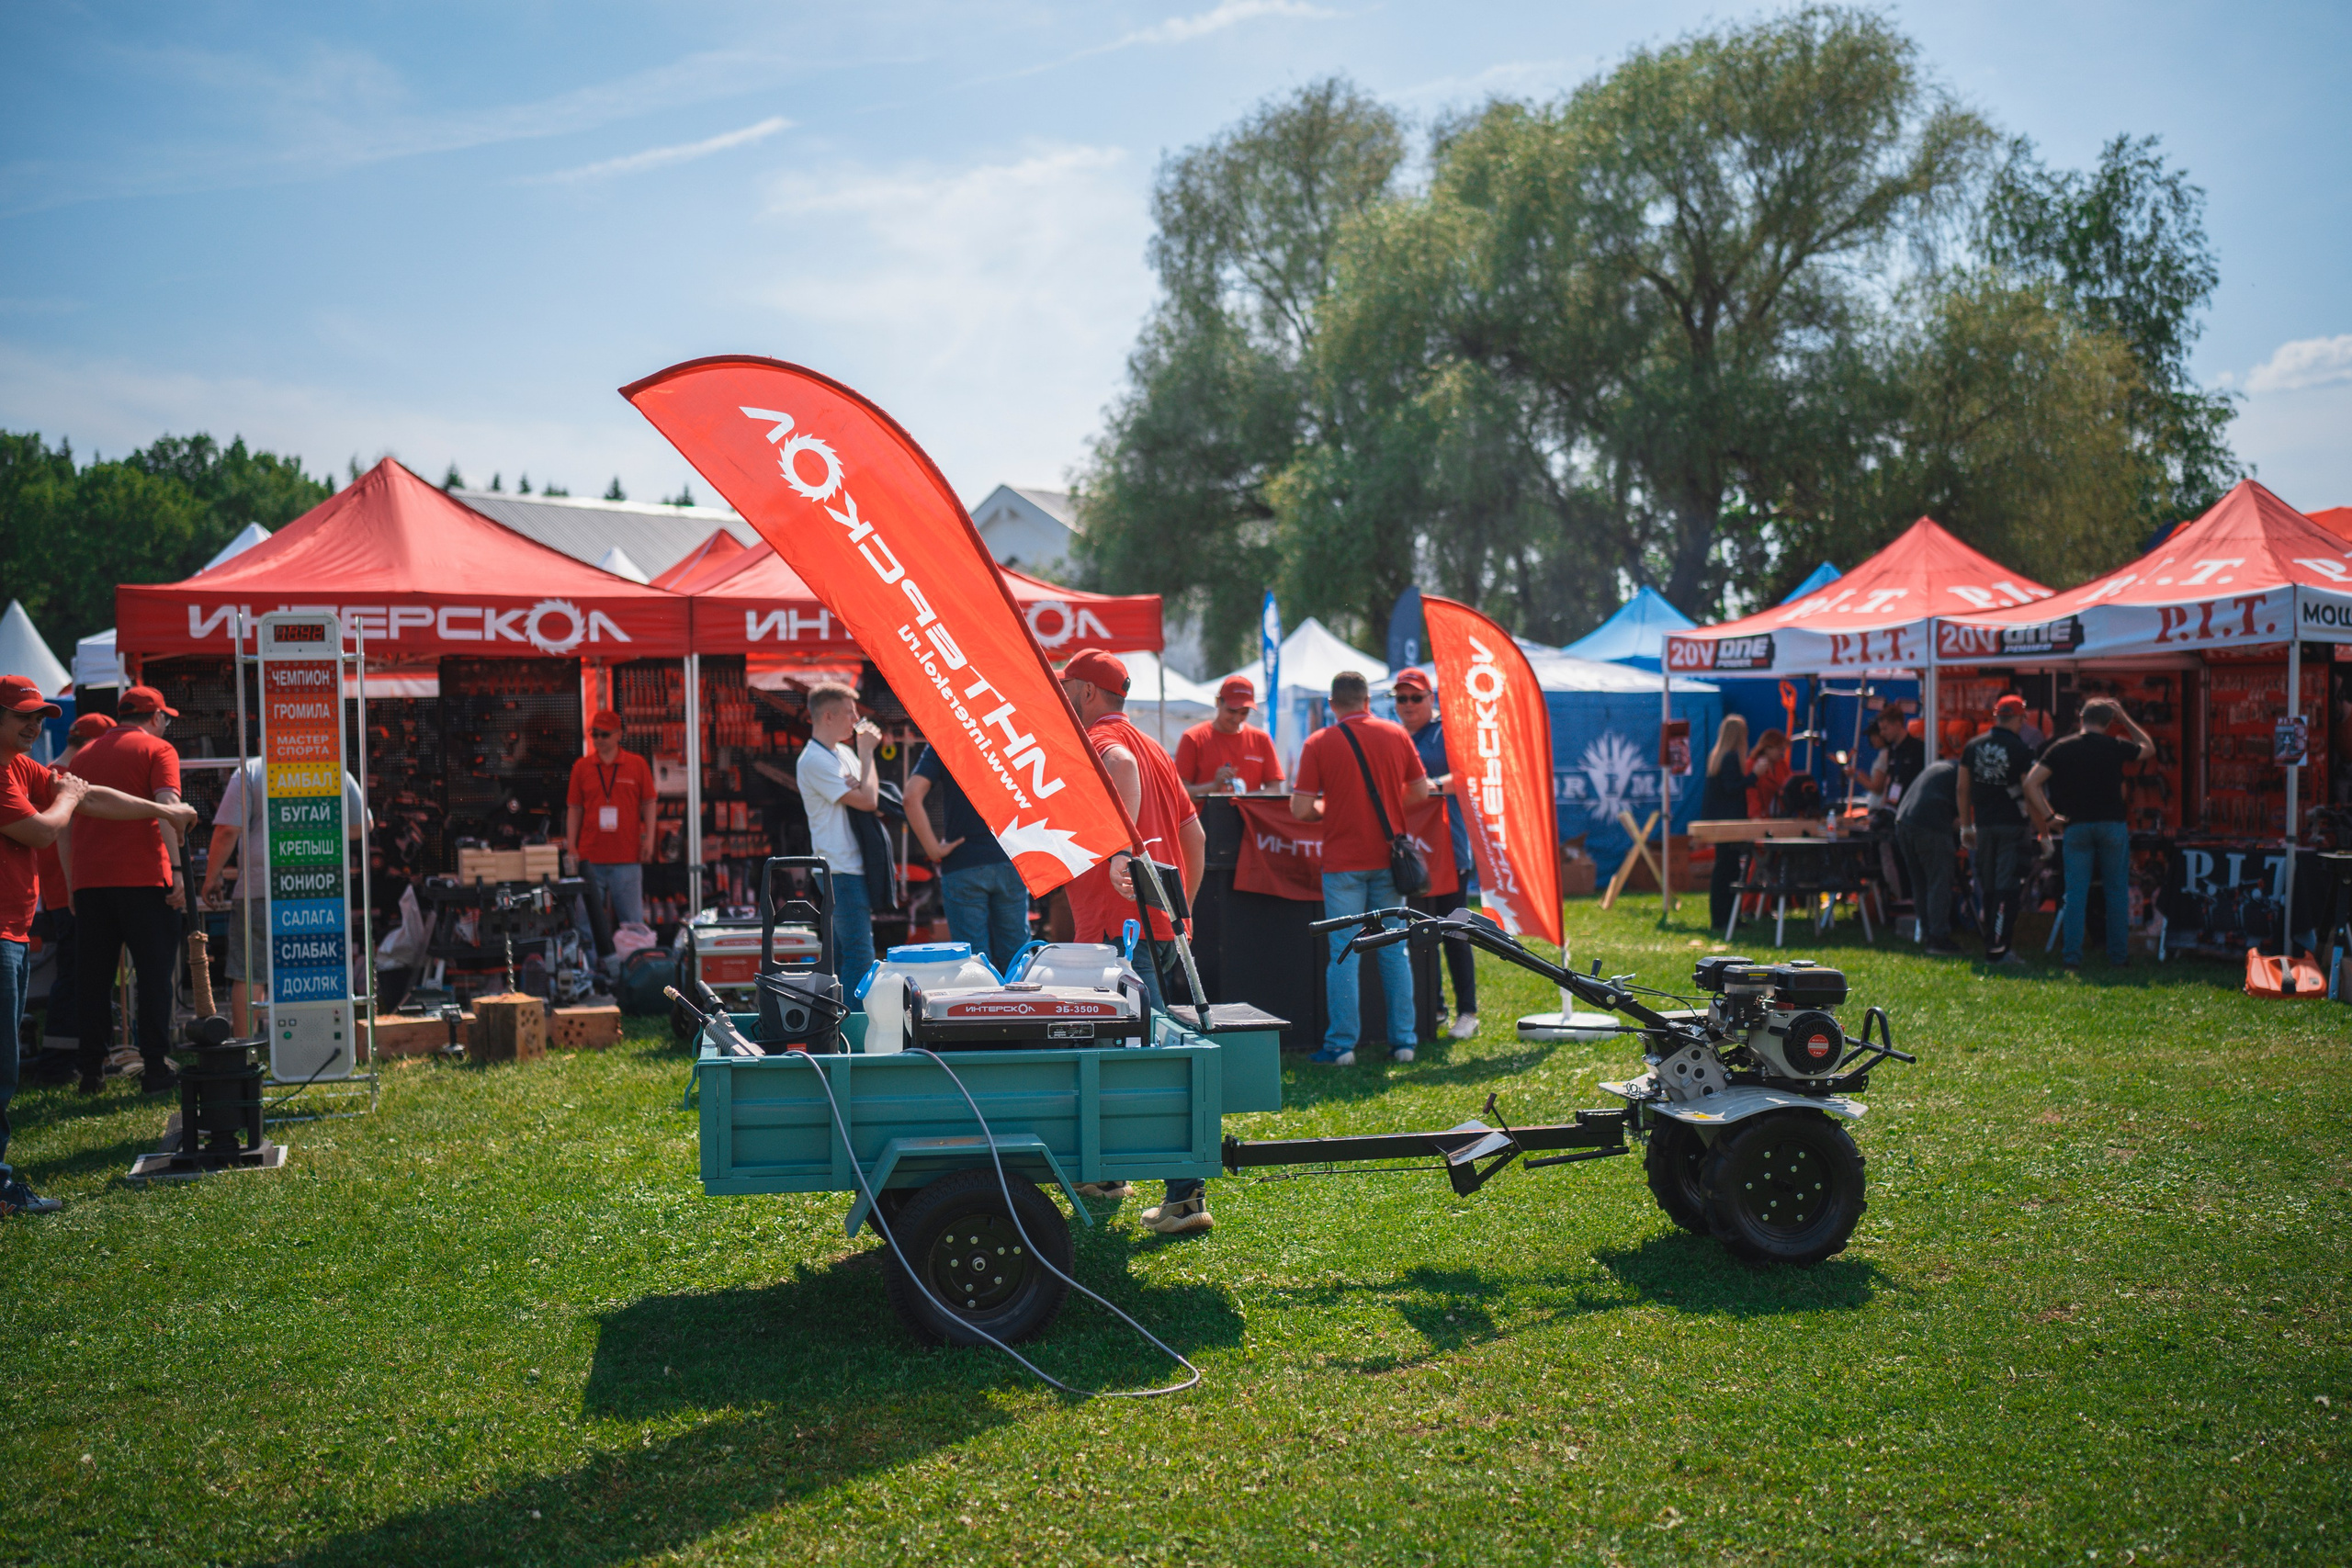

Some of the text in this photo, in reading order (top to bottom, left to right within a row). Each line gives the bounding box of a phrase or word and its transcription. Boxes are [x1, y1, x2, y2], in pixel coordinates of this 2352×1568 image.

[188, 598, 632, 656] ИНЕРСКОЛ
[2154, 594, 2277, 643] P.I.T.
[1829, 627, 1916, 665] P.I.T.
[1940, 623, 2000, 654] 20V
[1670, 637, 1716, 668] 20V
[272, 670, 330, 686] ЧЕМПИОН
[274, 704, 331, 719] ГРОМИЛА
[277, 736, 329, 745] МАСТЕР
[277, 746, 330, 756] СПОРТА
[277, 772, 333, 788] АМБАЛ
[281, 802, 331, 822] БУГАЙ
[279, 840, 334, 856] КРЕПЫШ
[280, 874, 335, 891] ЮНИОР
[282, 909, 335, 926] САЛАГА
[281, 942, 338, 960] СЛАБАК
[282, 976, 339, 997] ДОХЛЯК
[965, 1003, 1100, 1015] ИНТЕРСКОЛ ЭБ-3500
